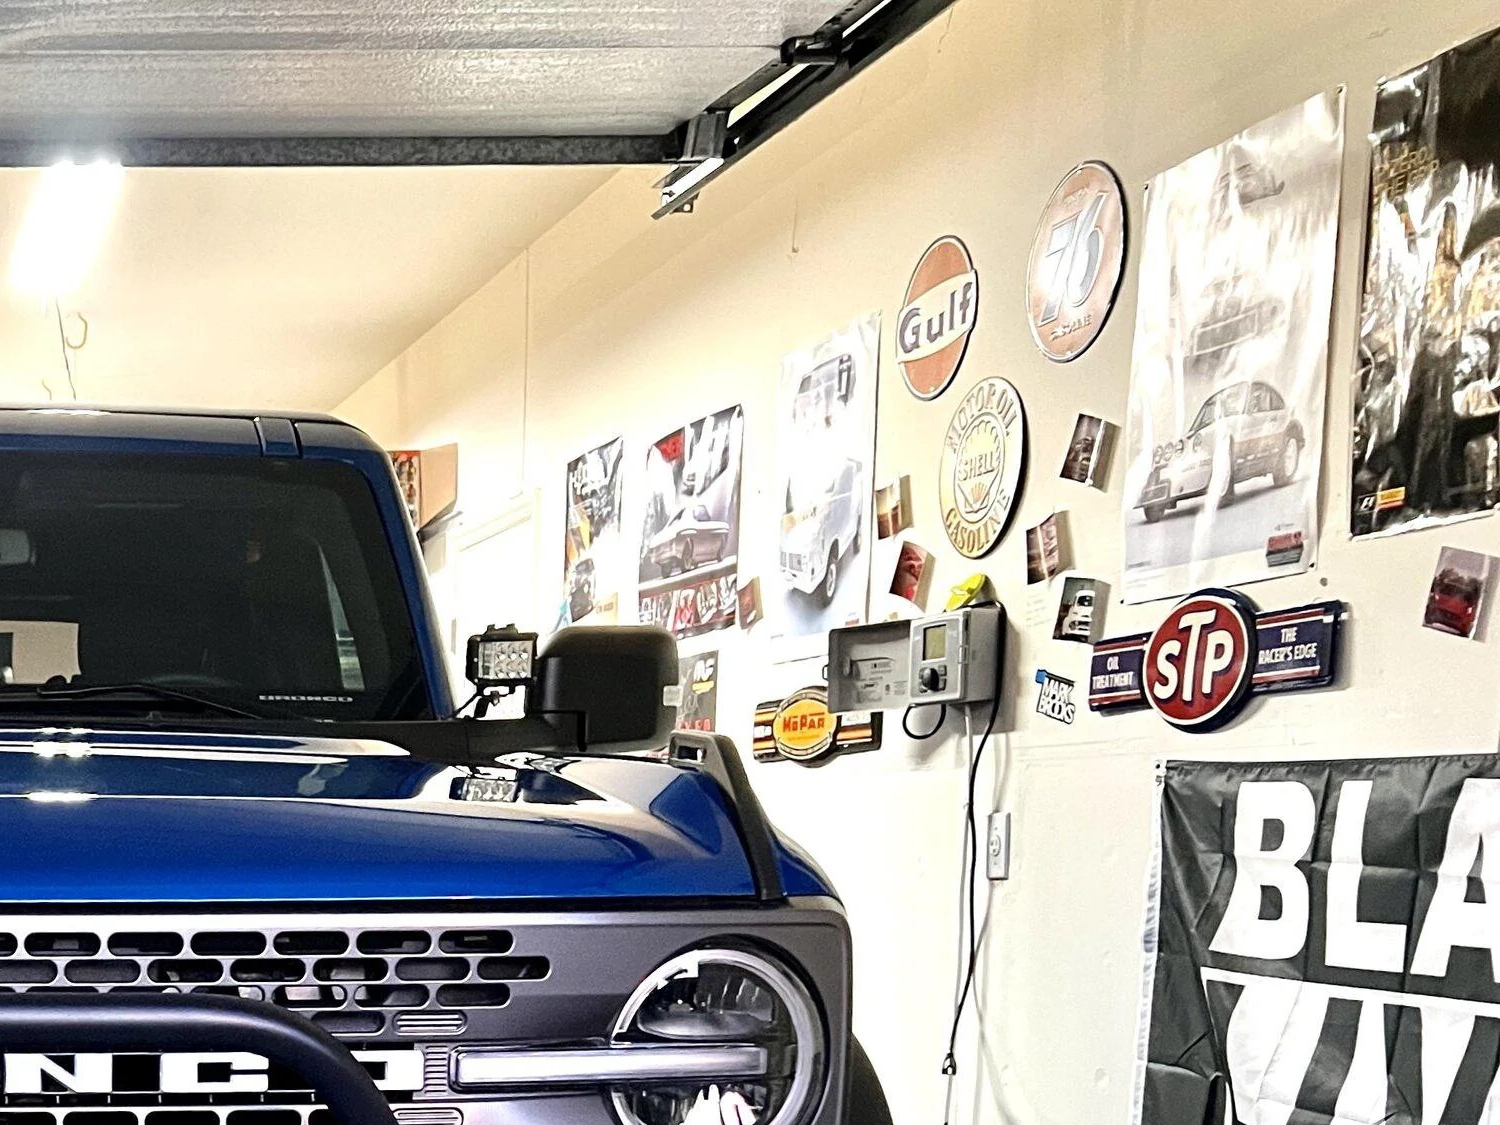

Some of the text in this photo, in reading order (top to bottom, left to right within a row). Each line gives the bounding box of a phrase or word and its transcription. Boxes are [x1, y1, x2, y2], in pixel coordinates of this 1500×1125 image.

[1039, 190, 1109, 327] 76
[899, 281, 973, 354] Gulf
[946, 383, 996, 454] MOTOR
[957, 450, 996, 481] SHELL
[944, 487, 1011, 554] GASOLINE
[1280, 626, 1298, 644] THE
[1106, 655, 1121, 671] OIL
[1153, 608, 1235, 702] STP
[1257, 641, 1319, 665] RACER'S EDGE
[1042, 678, 1074, 704] MARK
[1091, 671, 1135, 690] TREATMENT
